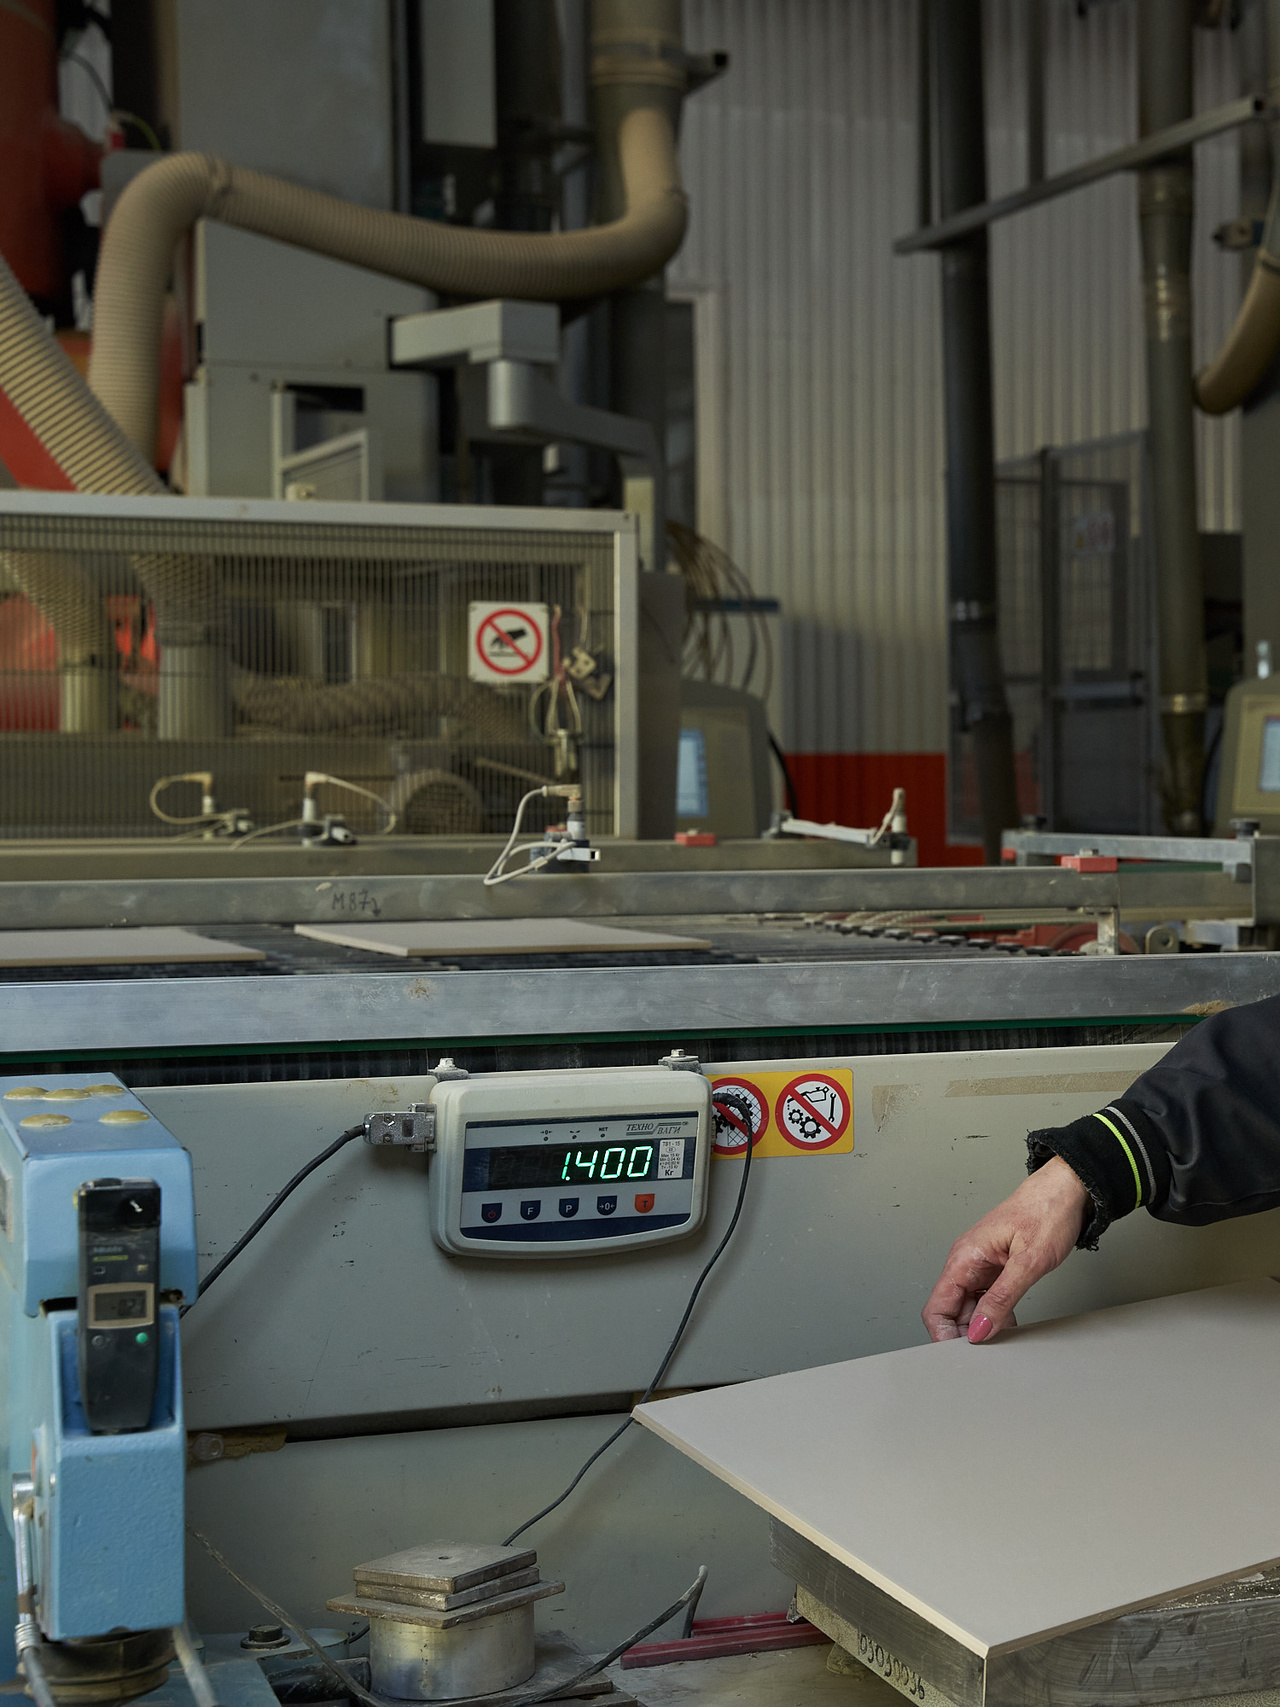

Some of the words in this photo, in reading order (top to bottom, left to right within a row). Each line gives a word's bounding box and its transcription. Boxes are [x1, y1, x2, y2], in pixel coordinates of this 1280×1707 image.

[561, 1146, 653, 1181] 1.400
[527, 1207, 534, 1216] F
[565, 1204, 573, 1213] P
